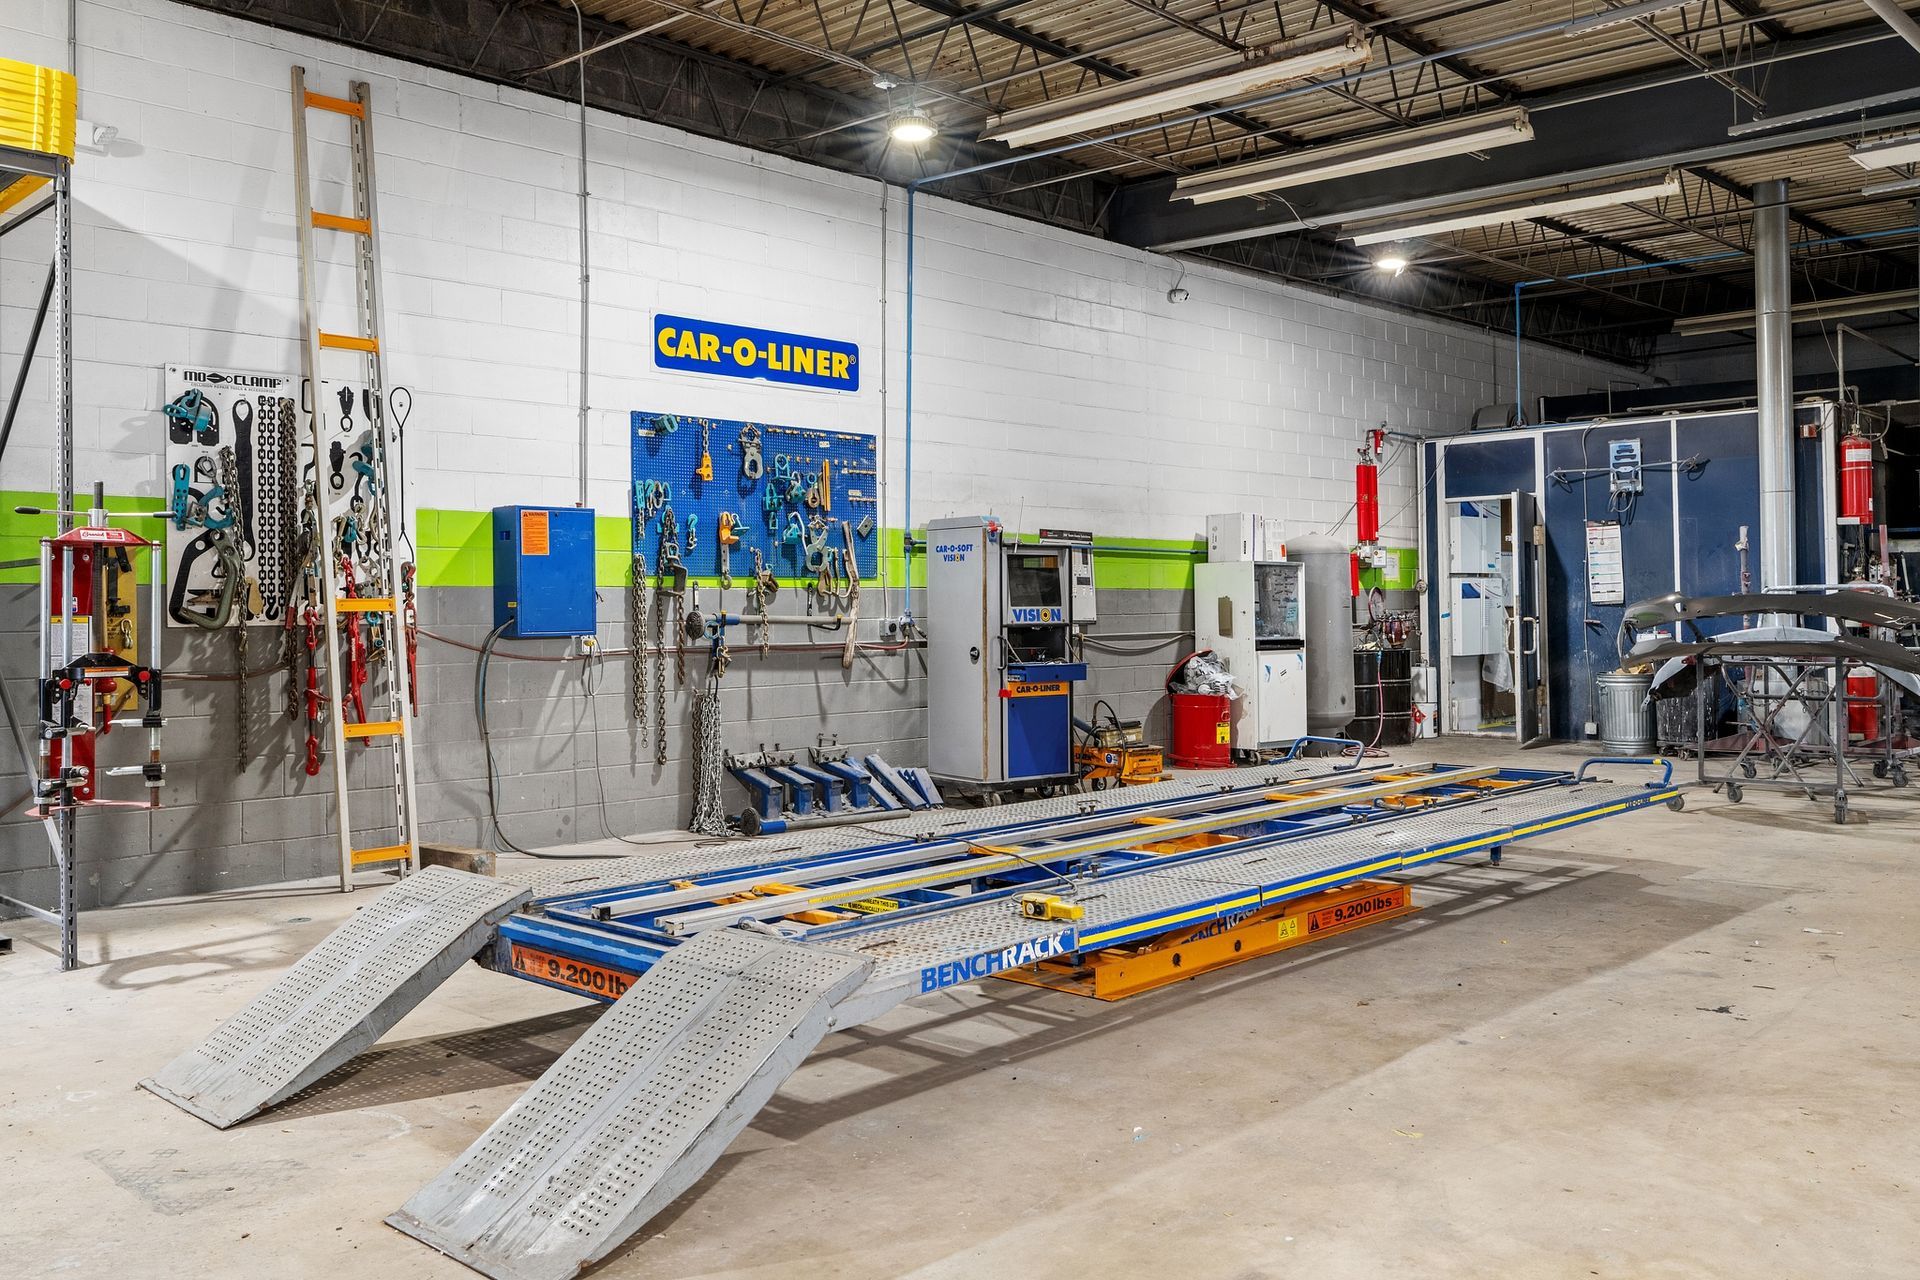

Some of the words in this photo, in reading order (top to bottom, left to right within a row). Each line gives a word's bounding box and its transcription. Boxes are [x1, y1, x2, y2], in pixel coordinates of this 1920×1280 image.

[935, 544, 973, 553] CAR-O-SOFT
[943, 553, 965, 562] VISION
[1012, 608, 1062, 622] VISION
[1016, 684, 1060, 693] CAR-O-LINER
